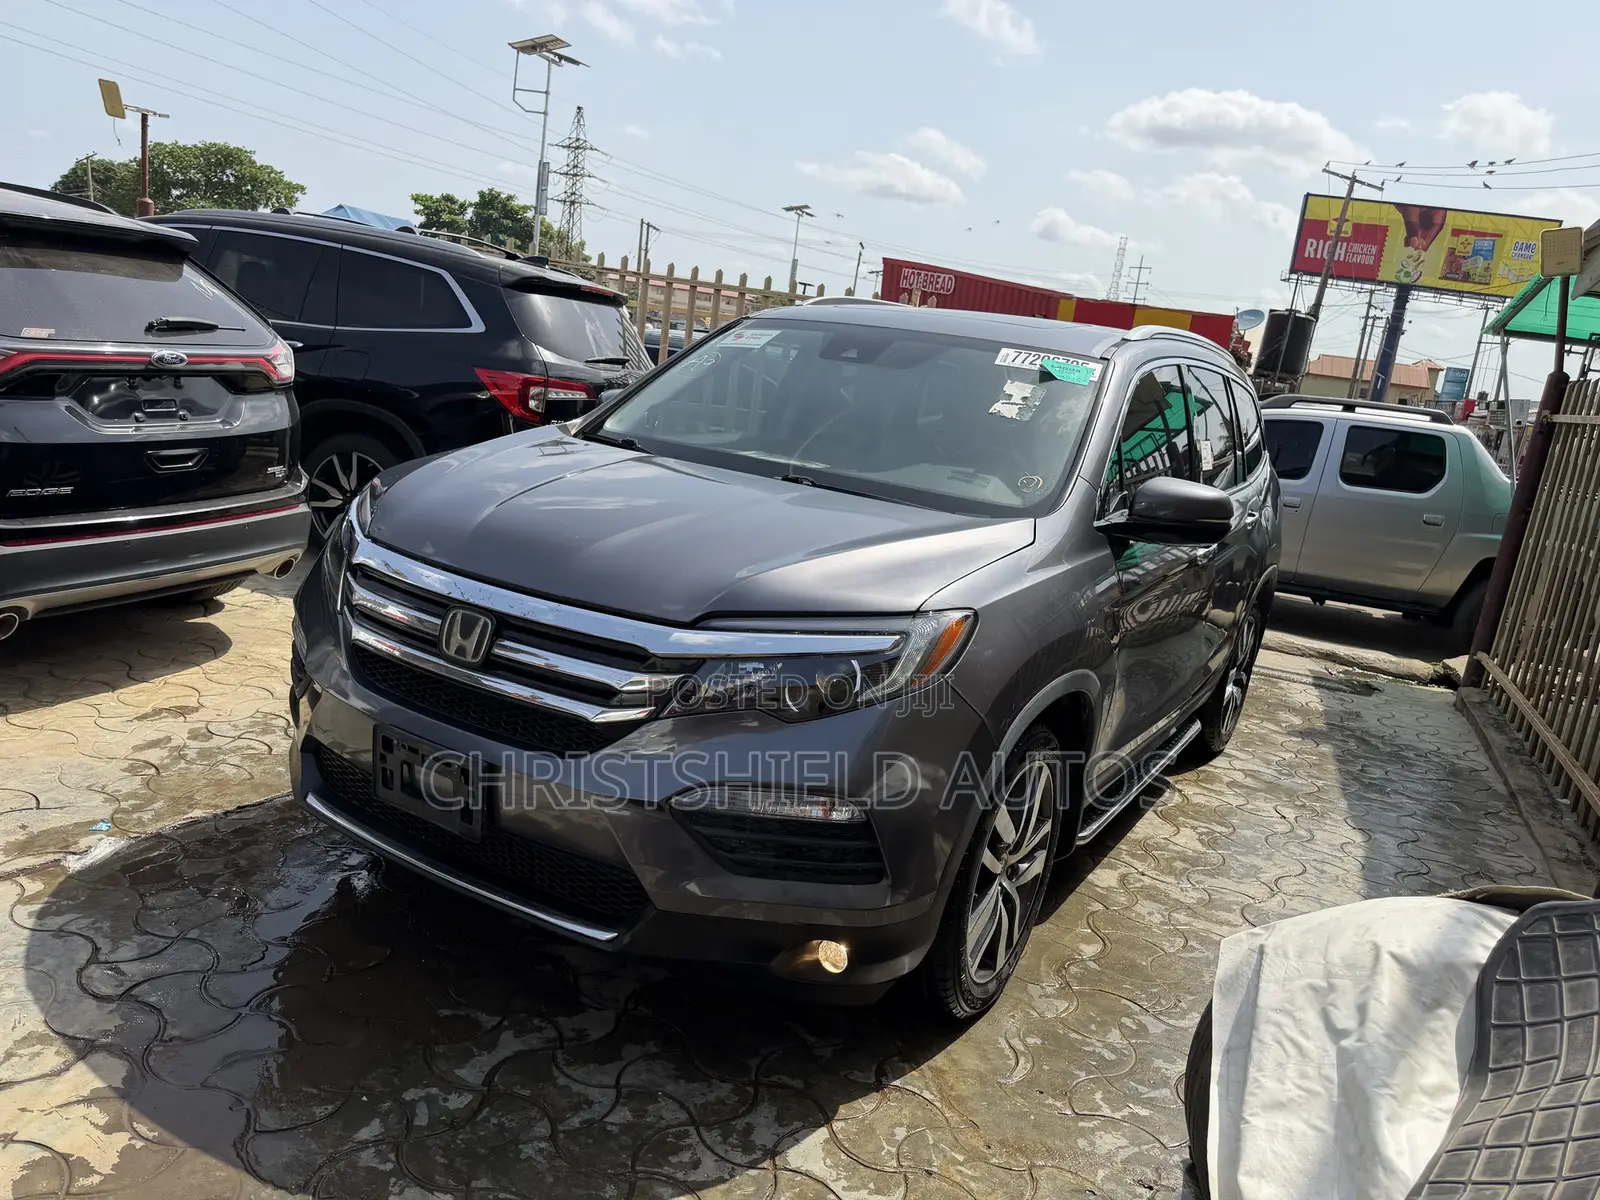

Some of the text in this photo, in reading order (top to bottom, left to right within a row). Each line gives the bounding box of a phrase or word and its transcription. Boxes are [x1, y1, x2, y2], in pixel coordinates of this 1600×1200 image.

[1304, 238, 1347, 261] RICH
[1347, 242, 1377, 255] CHICKEN
[1345, 252, 1375, 265] FLAVOUR
[900, 268, 955, 294] HOT BREAD
[163, 354, 180, 364] Ford
[5, 486, 75, 497] EDGE
